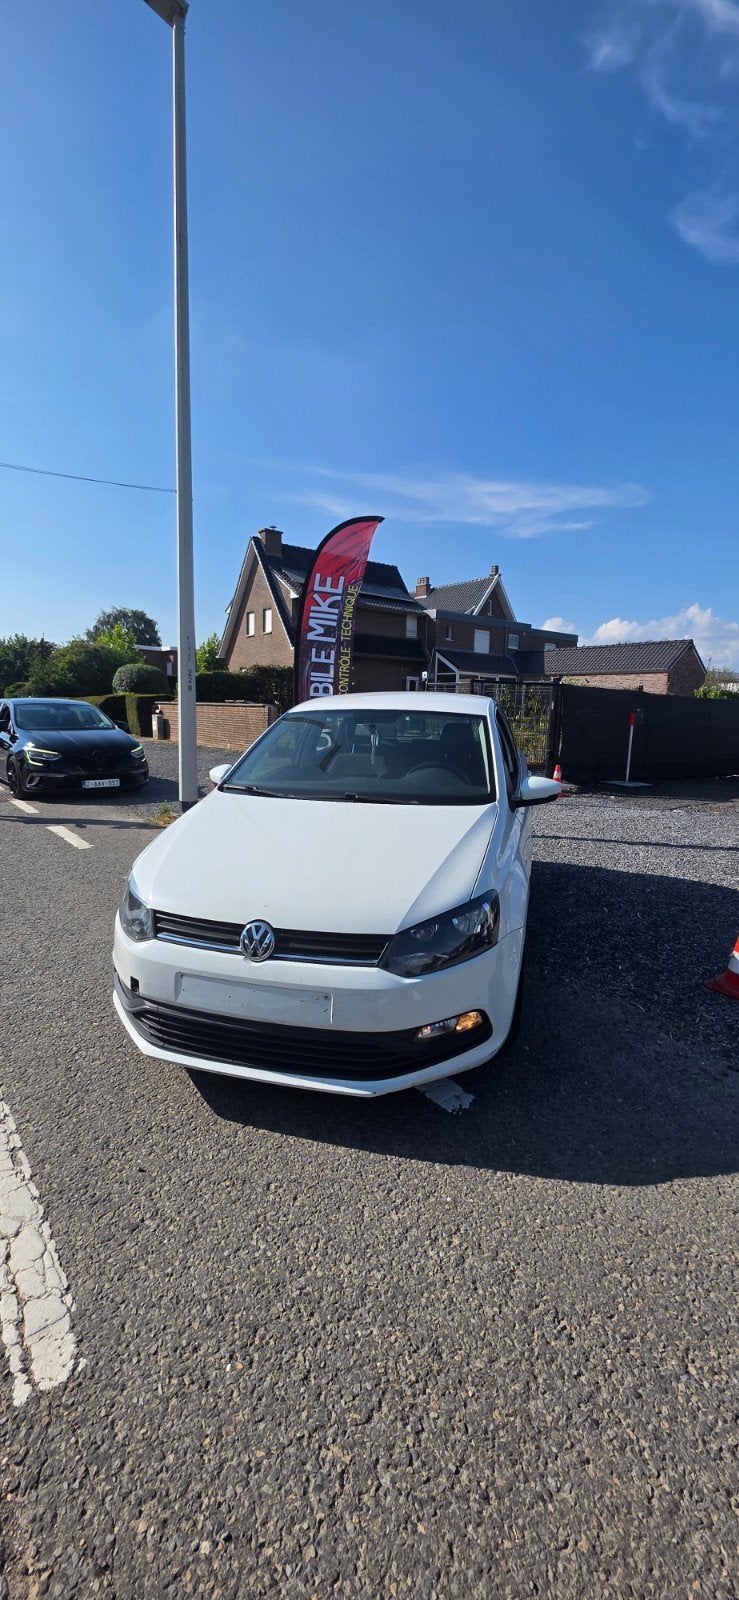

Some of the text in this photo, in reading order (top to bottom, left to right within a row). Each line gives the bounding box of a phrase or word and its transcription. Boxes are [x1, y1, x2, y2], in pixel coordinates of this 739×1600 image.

[307, 573, 345, 643] MIKE
[341, 584, 360, 641] TECHNIQUE
[241, 920, 275, 961] VW
